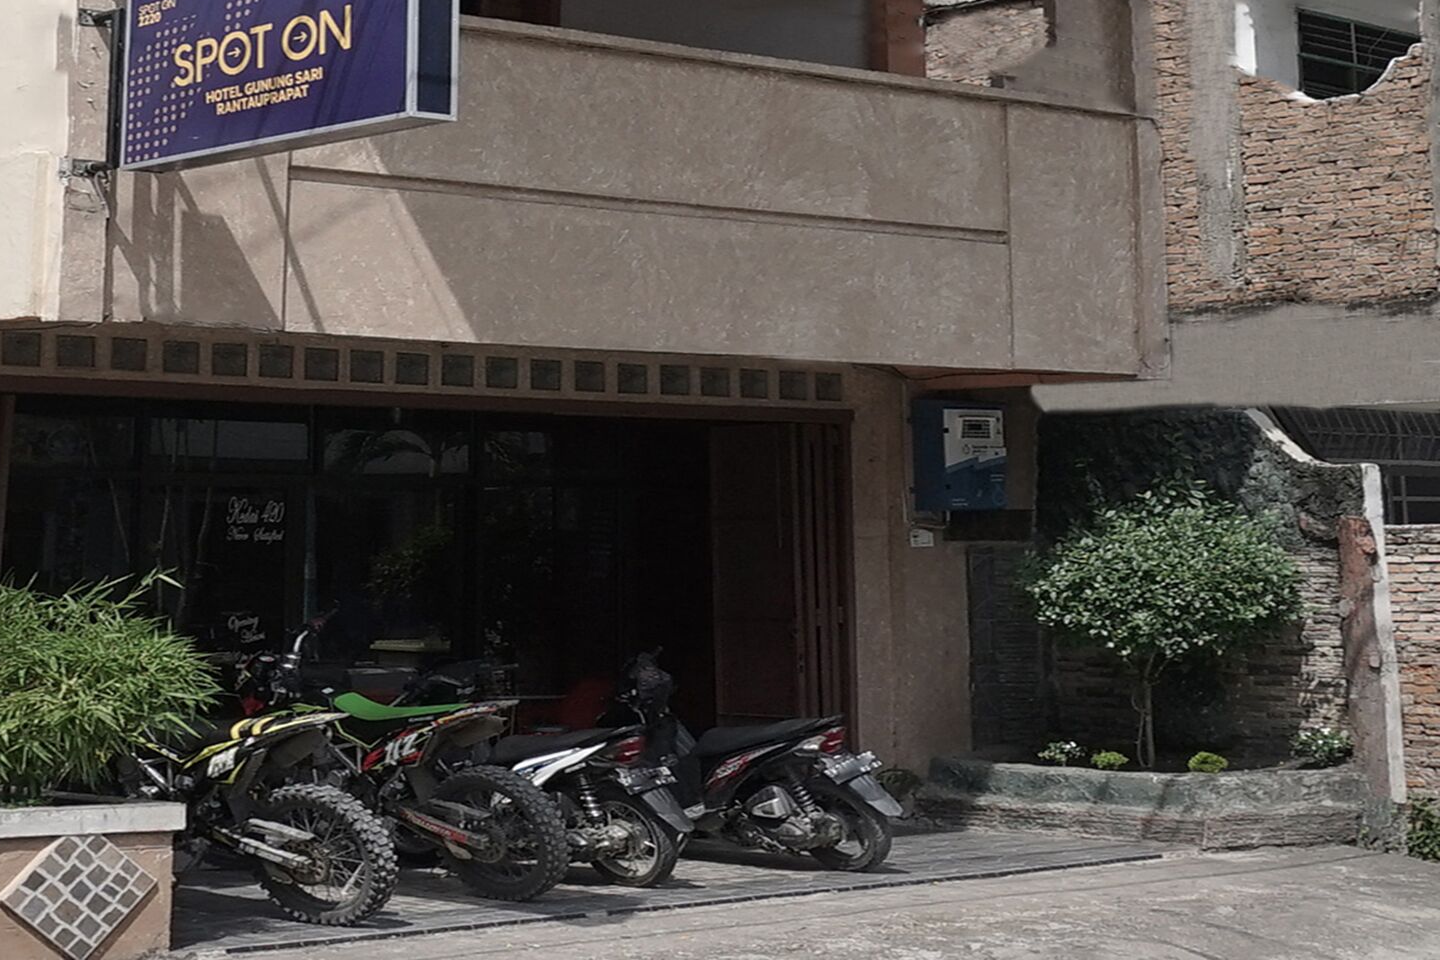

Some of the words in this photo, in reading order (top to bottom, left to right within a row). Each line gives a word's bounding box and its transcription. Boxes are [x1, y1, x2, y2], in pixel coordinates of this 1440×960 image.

[138, 1, 160, 16] SPOT
[173, 22, 273, 87] SPOT
[281, 4, 352, 62] ON
[205, 85, 244, 104] HOTEL
[244, 73, 294, 95] GUNUNG
[295, 66, 324, 85] SARI
[216, 84, 310, 116] RANTAUPRAPAT
